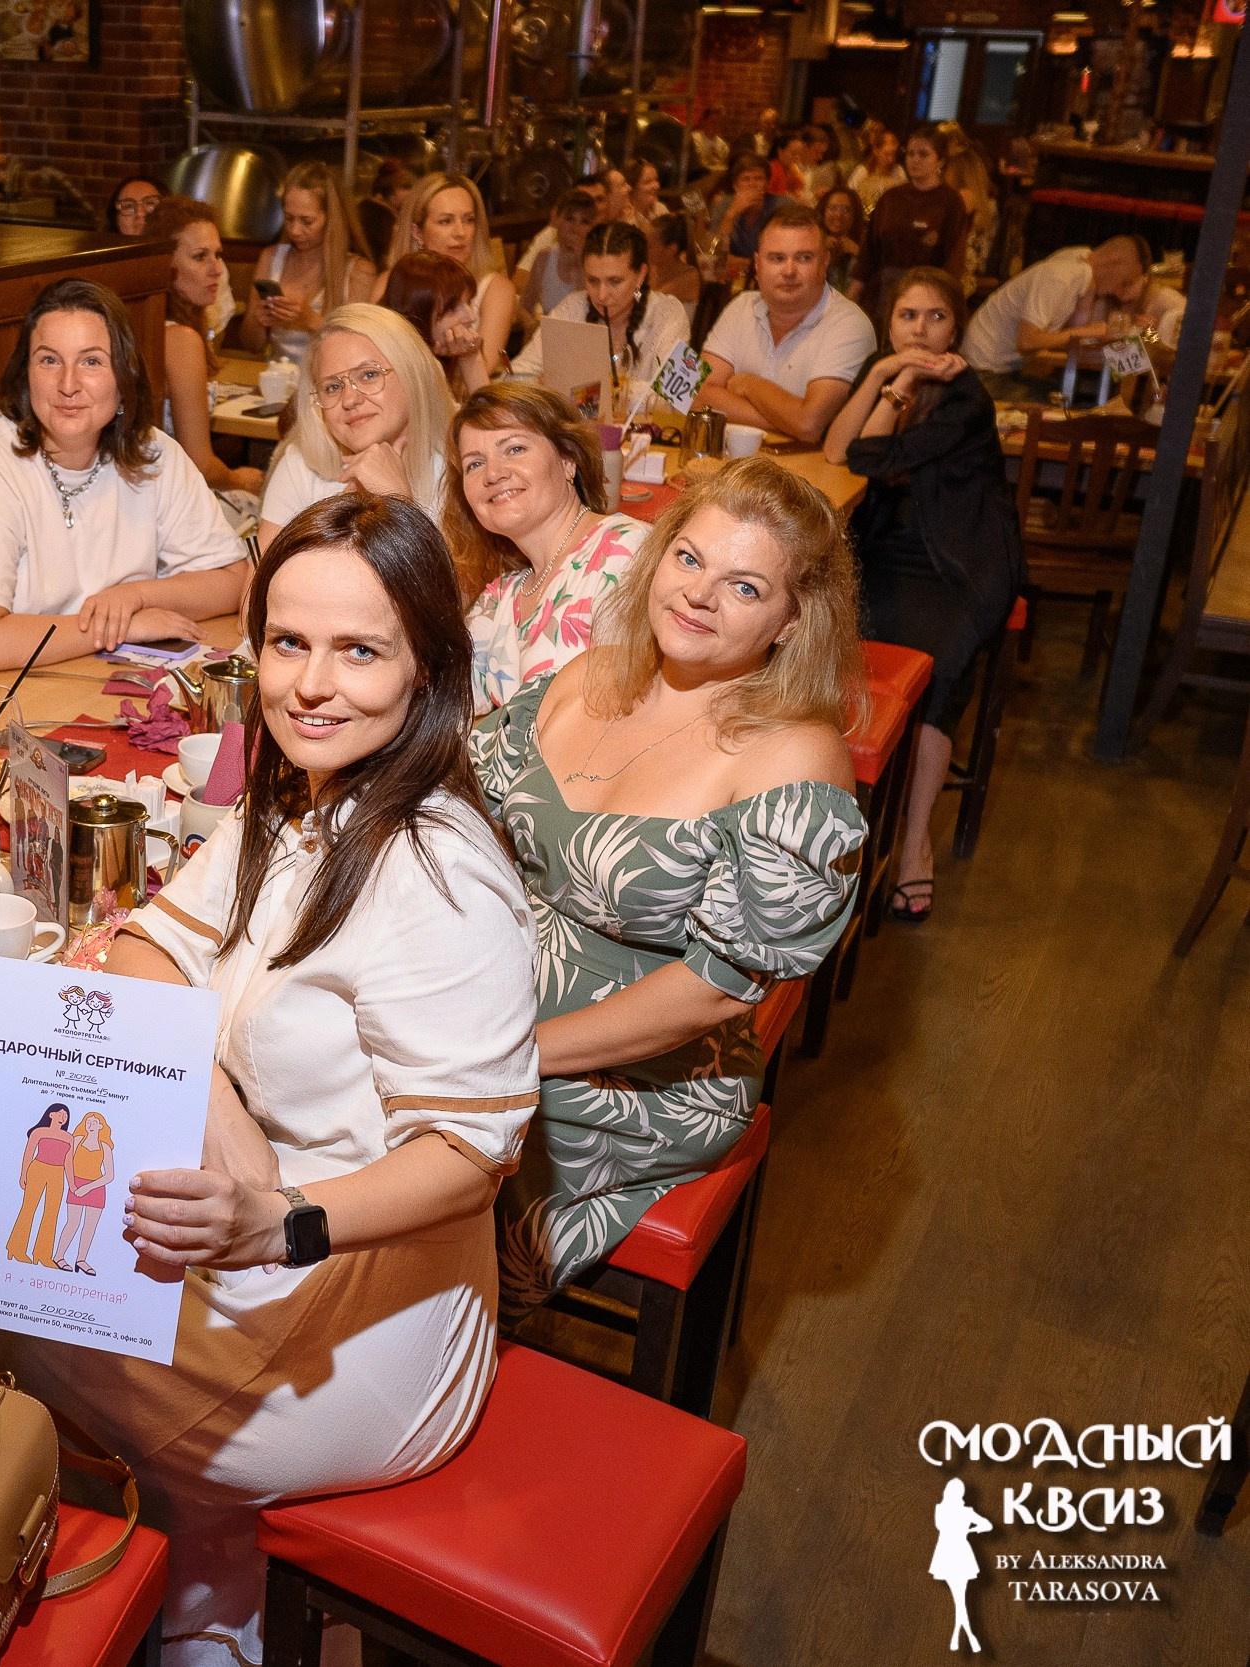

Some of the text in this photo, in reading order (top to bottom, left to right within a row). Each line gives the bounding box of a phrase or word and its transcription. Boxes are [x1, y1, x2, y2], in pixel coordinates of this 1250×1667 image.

[664, 371, 692, 403] 102
[85, 1054, 187, 1082] СЕРТИФИКАТ
[21, 1076, 70, 1091] Длительность
[70, 1086, 97, 1095] съемки
[108, 1092, 130, 1101] минут
[56, 1091, 75, 1099] героев
[18, 1304, 28, 1312] до
[19, 1313, 51, 1325] Ванцетти
[62, 1323, 87, 1333] корпус
[94, 1329, 112, 1338] этаж
[120, 1334, 138, 1345] офис
[138, 1336, 153, 1347] 300
